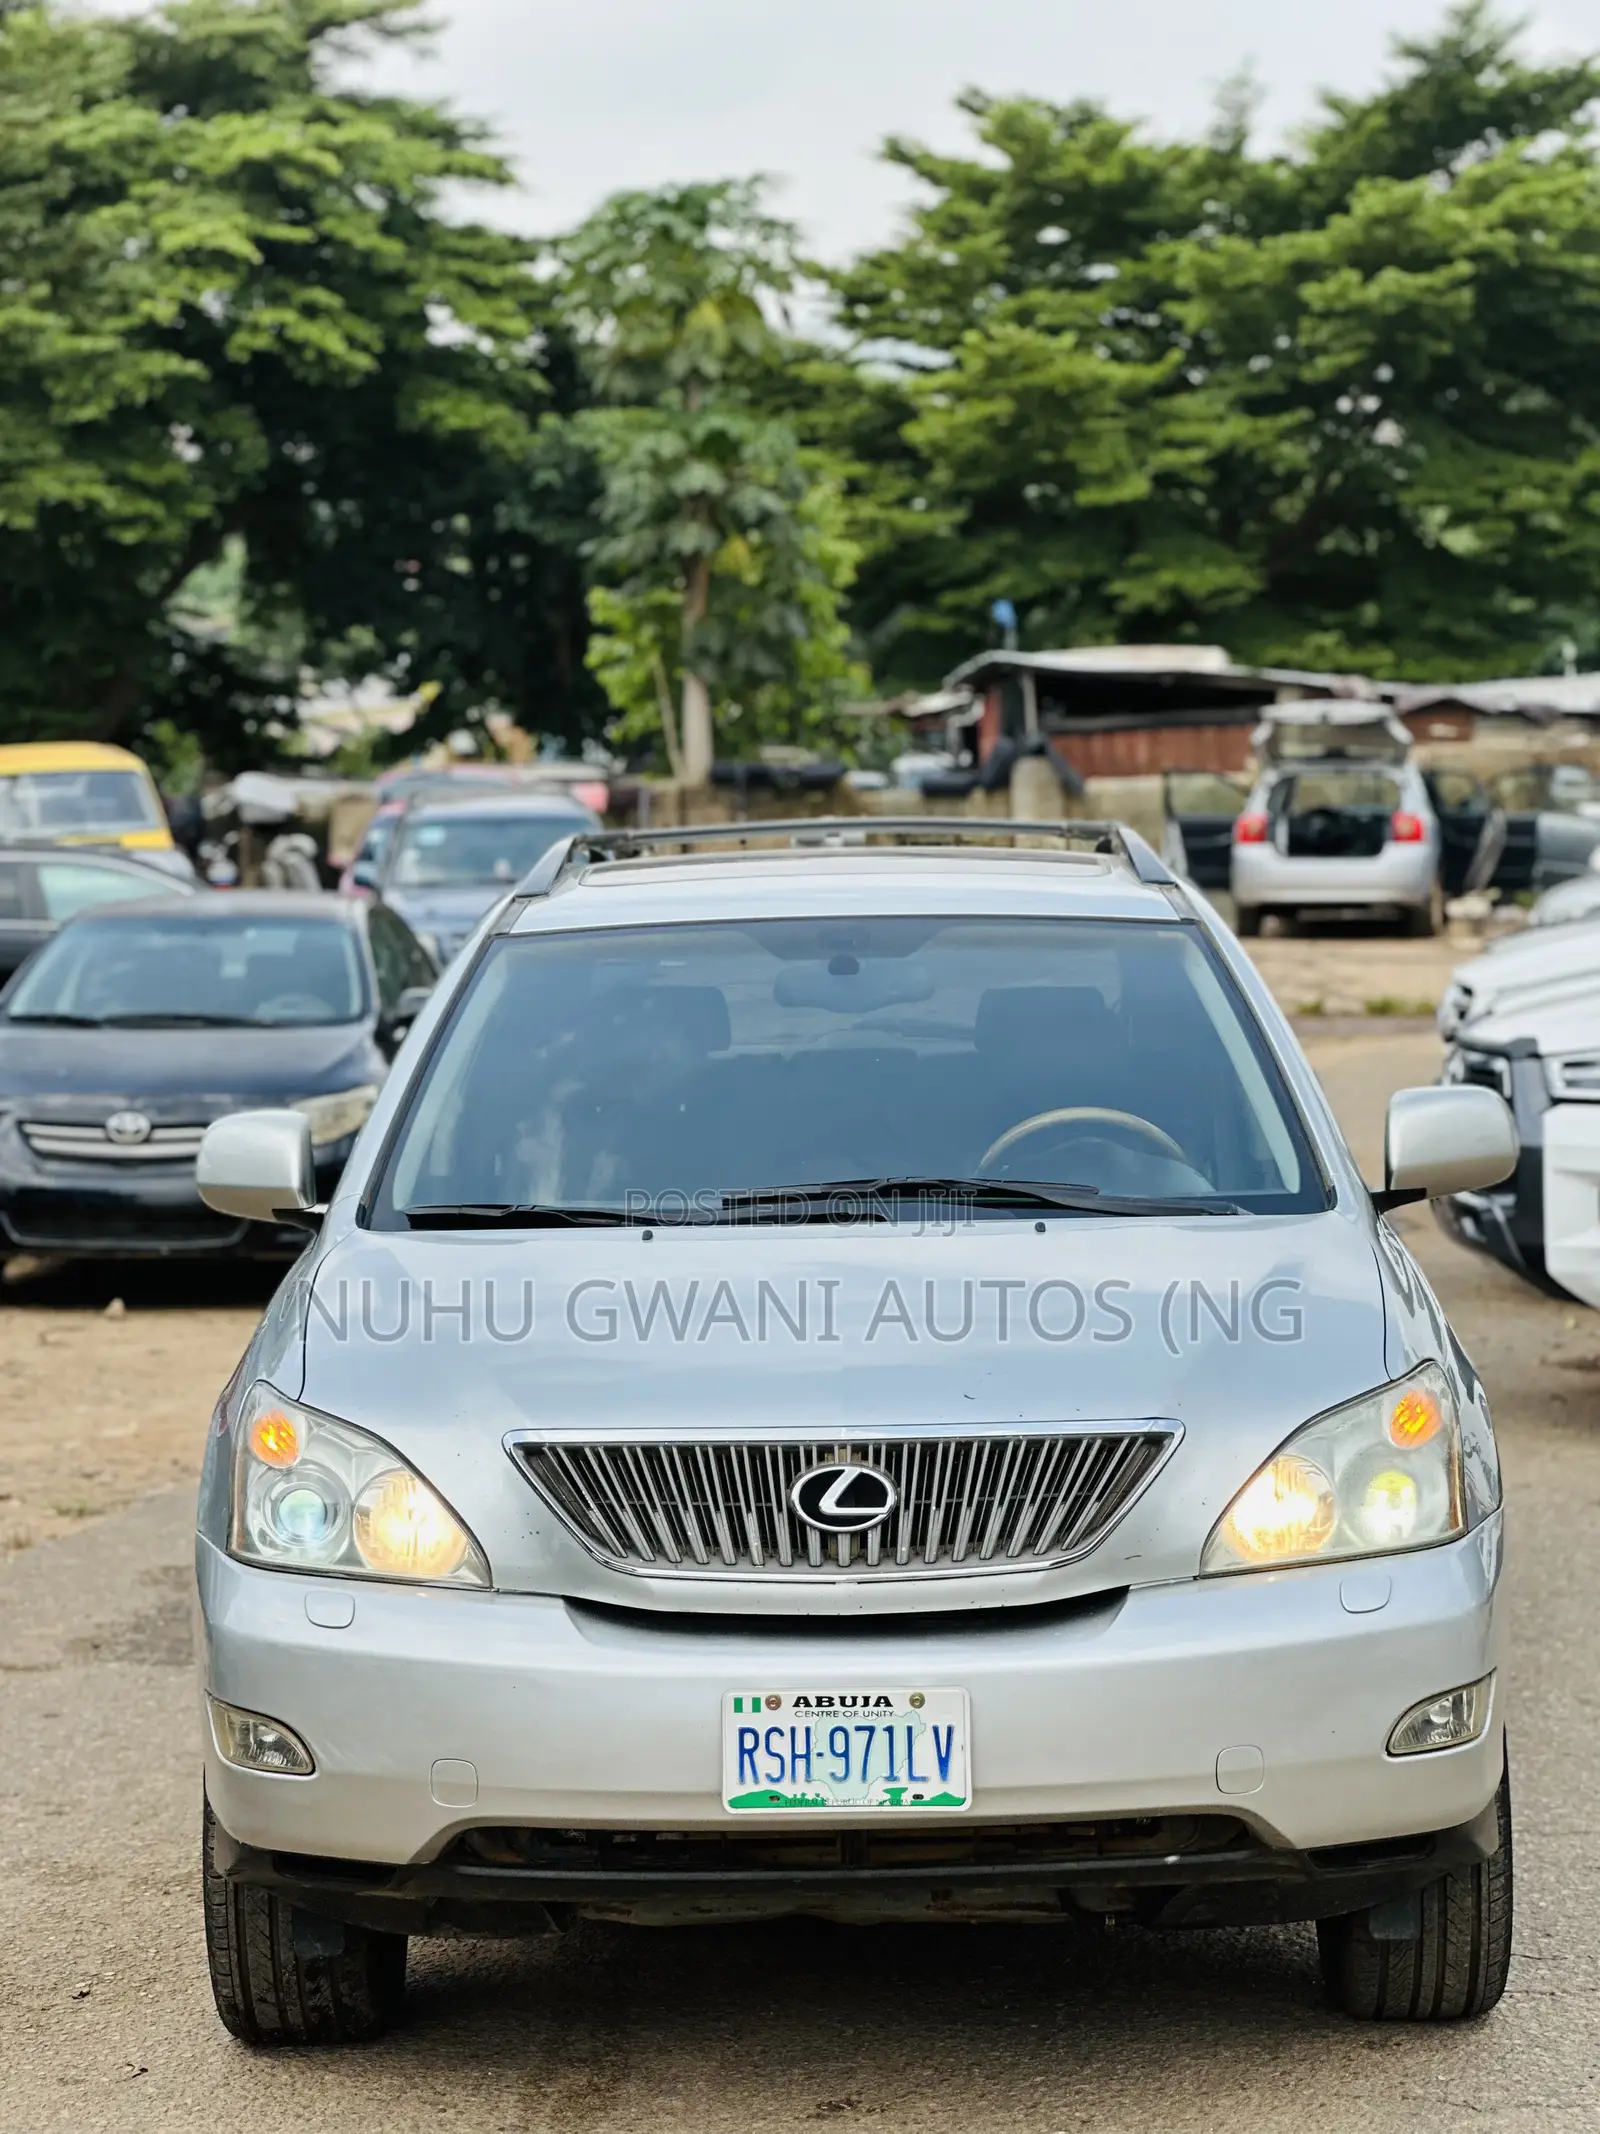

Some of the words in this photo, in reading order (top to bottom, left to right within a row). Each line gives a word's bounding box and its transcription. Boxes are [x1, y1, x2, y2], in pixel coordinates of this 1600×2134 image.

[792, 1695, 894, 1708] ABUJA
[794, 1710, 840, 1718] CENTRE
[842, 1710, 860, 1718] OF
[862, 1710, 895, 1718] UNITY
[737, 1724, 955, 1785] RSH-971LV
